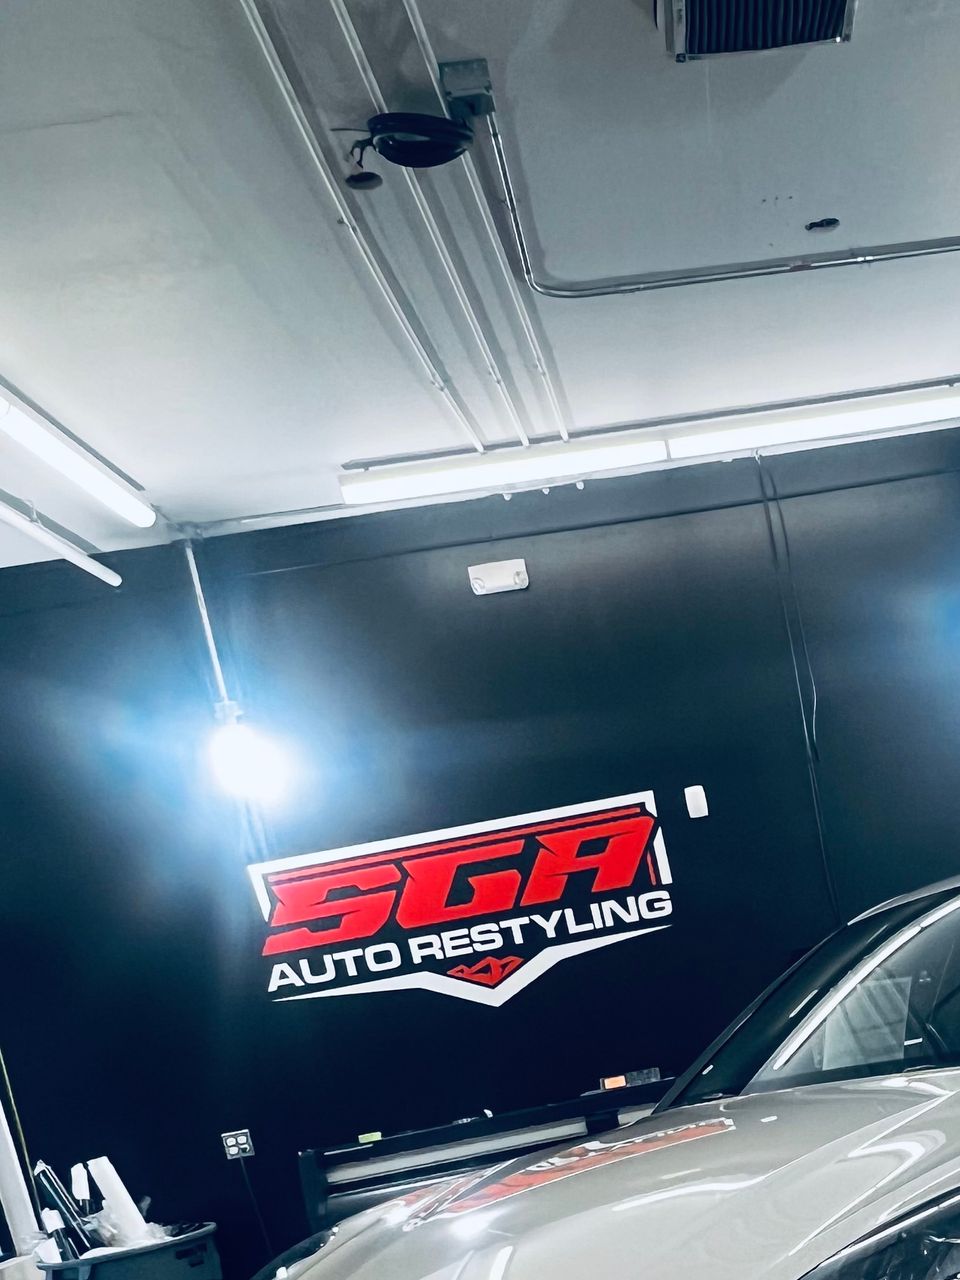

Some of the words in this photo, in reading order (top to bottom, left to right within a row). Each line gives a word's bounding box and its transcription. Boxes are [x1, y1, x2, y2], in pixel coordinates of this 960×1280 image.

[262, 816, 656, 956] SGA
[267, 942, 401, 993] AUTO
[408, 890, 673, 965] RESTYLING
